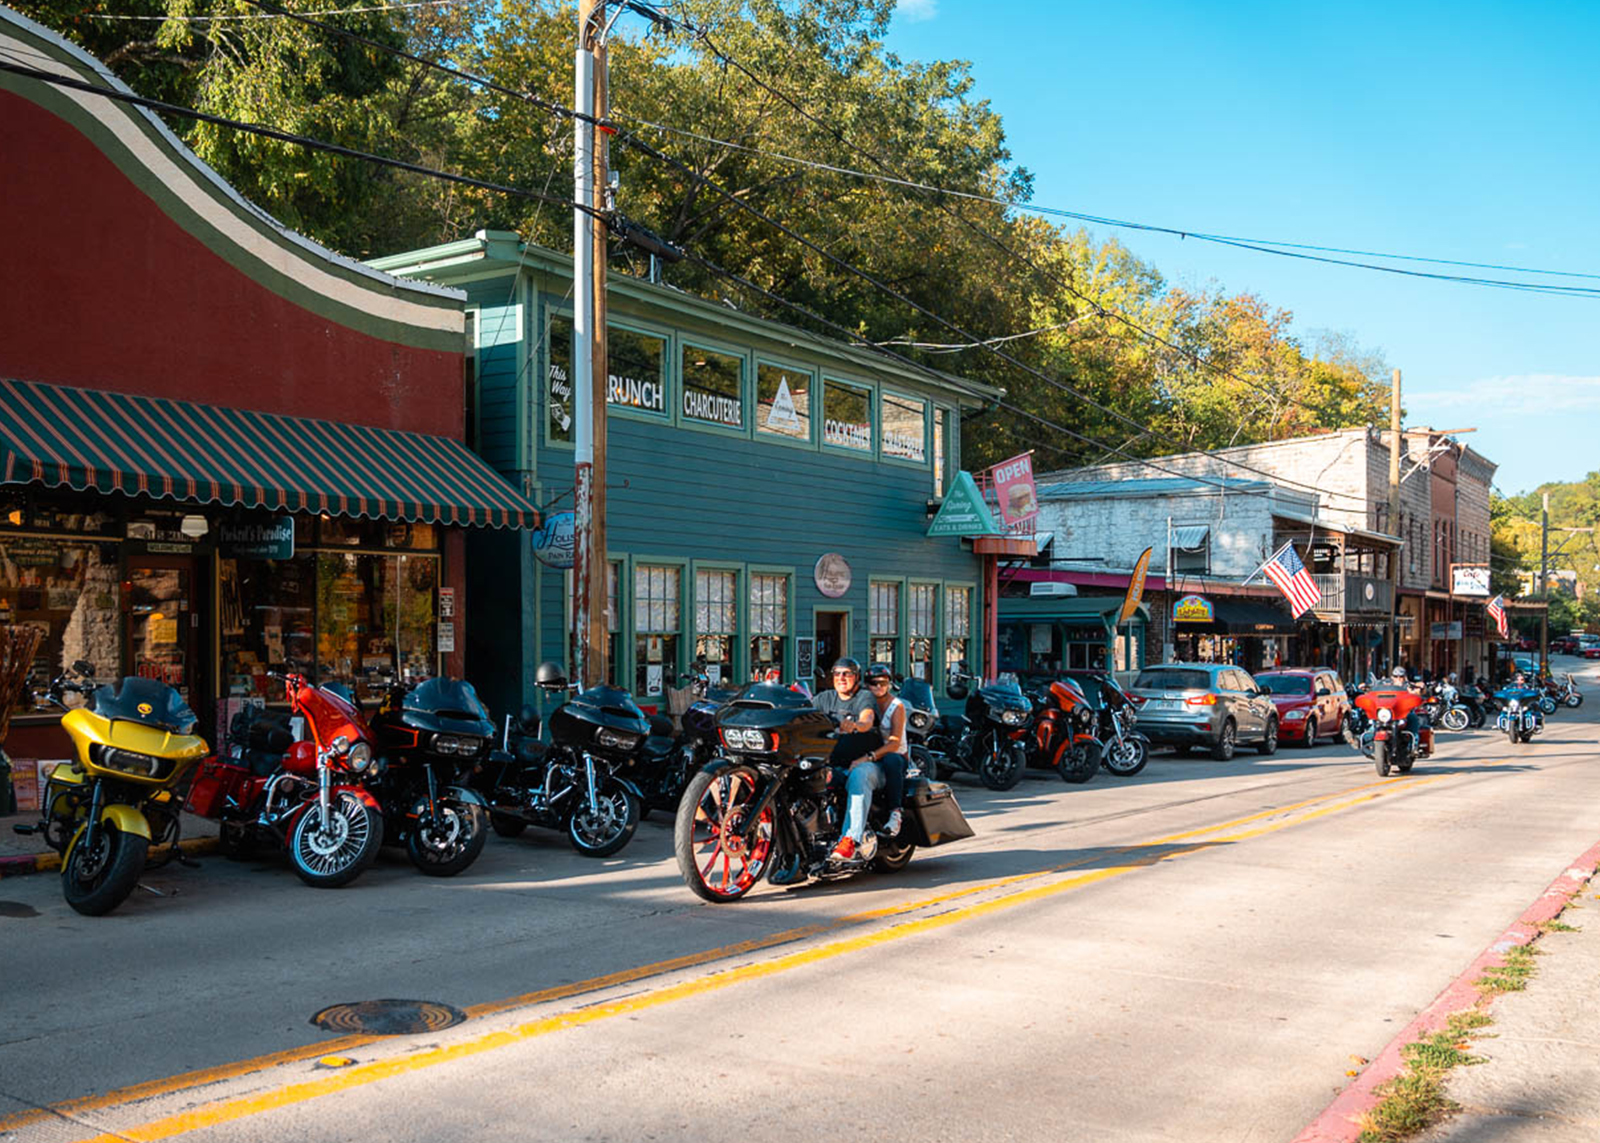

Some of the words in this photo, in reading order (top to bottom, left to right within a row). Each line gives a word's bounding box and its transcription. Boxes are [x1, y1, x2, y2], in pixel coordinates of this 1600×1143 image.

[549, 365, 567, 381] This
[551, 381, 571, 402] Way
[606, 374, 663, 409] RUNCH
[684, 390, 741, 423] CHARCUTERIE
[996, 459, 1030, 484] OPEN
[256, 525, 291, 542] Paradise
